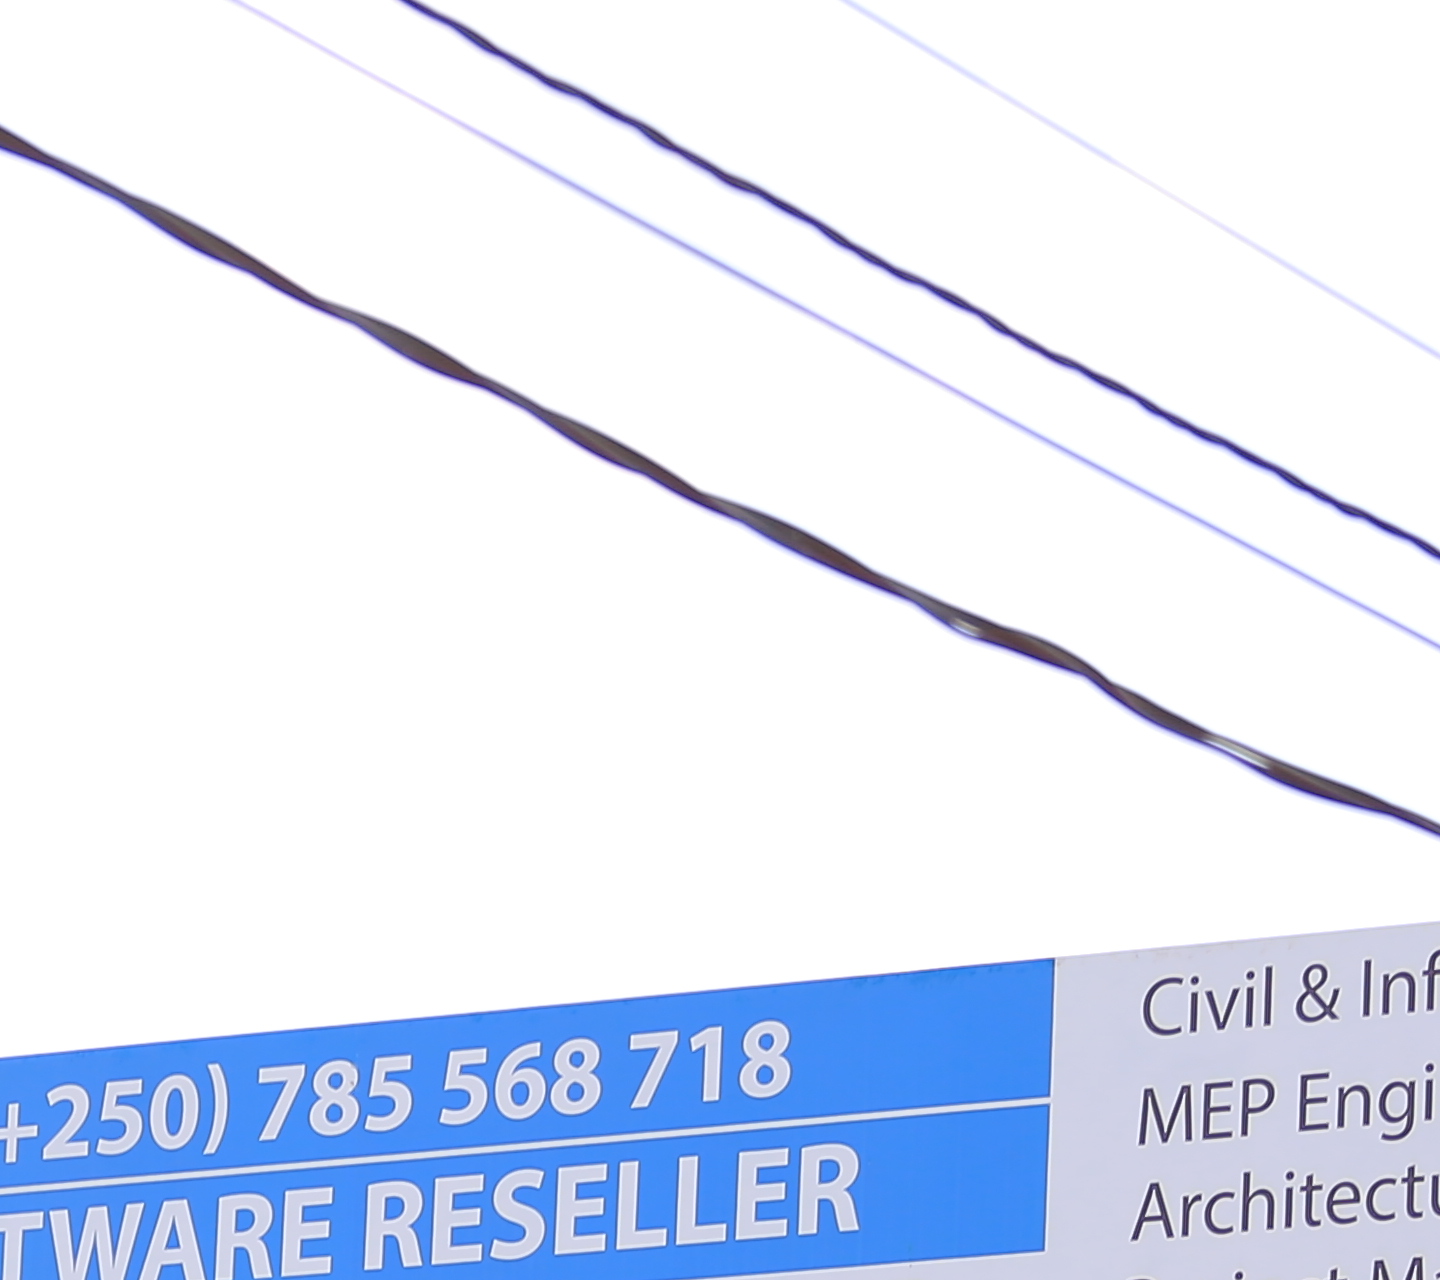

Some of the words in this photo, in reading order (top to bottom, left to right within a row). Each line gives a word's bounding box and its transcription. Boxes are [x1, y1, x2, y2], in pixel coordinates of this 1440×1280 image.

[1142, 964, 1275, 1037] Civil
[1294, 962, 1341, 1025] &
[257, 1054, 413, 1141] 785
[438, 1038, 602, 1125] 568
[628, 1019, 792, 1109] 718
[1138, 1077, 1276, 1146] MEP
[363, 1143, 860, 1272] RESELLER
